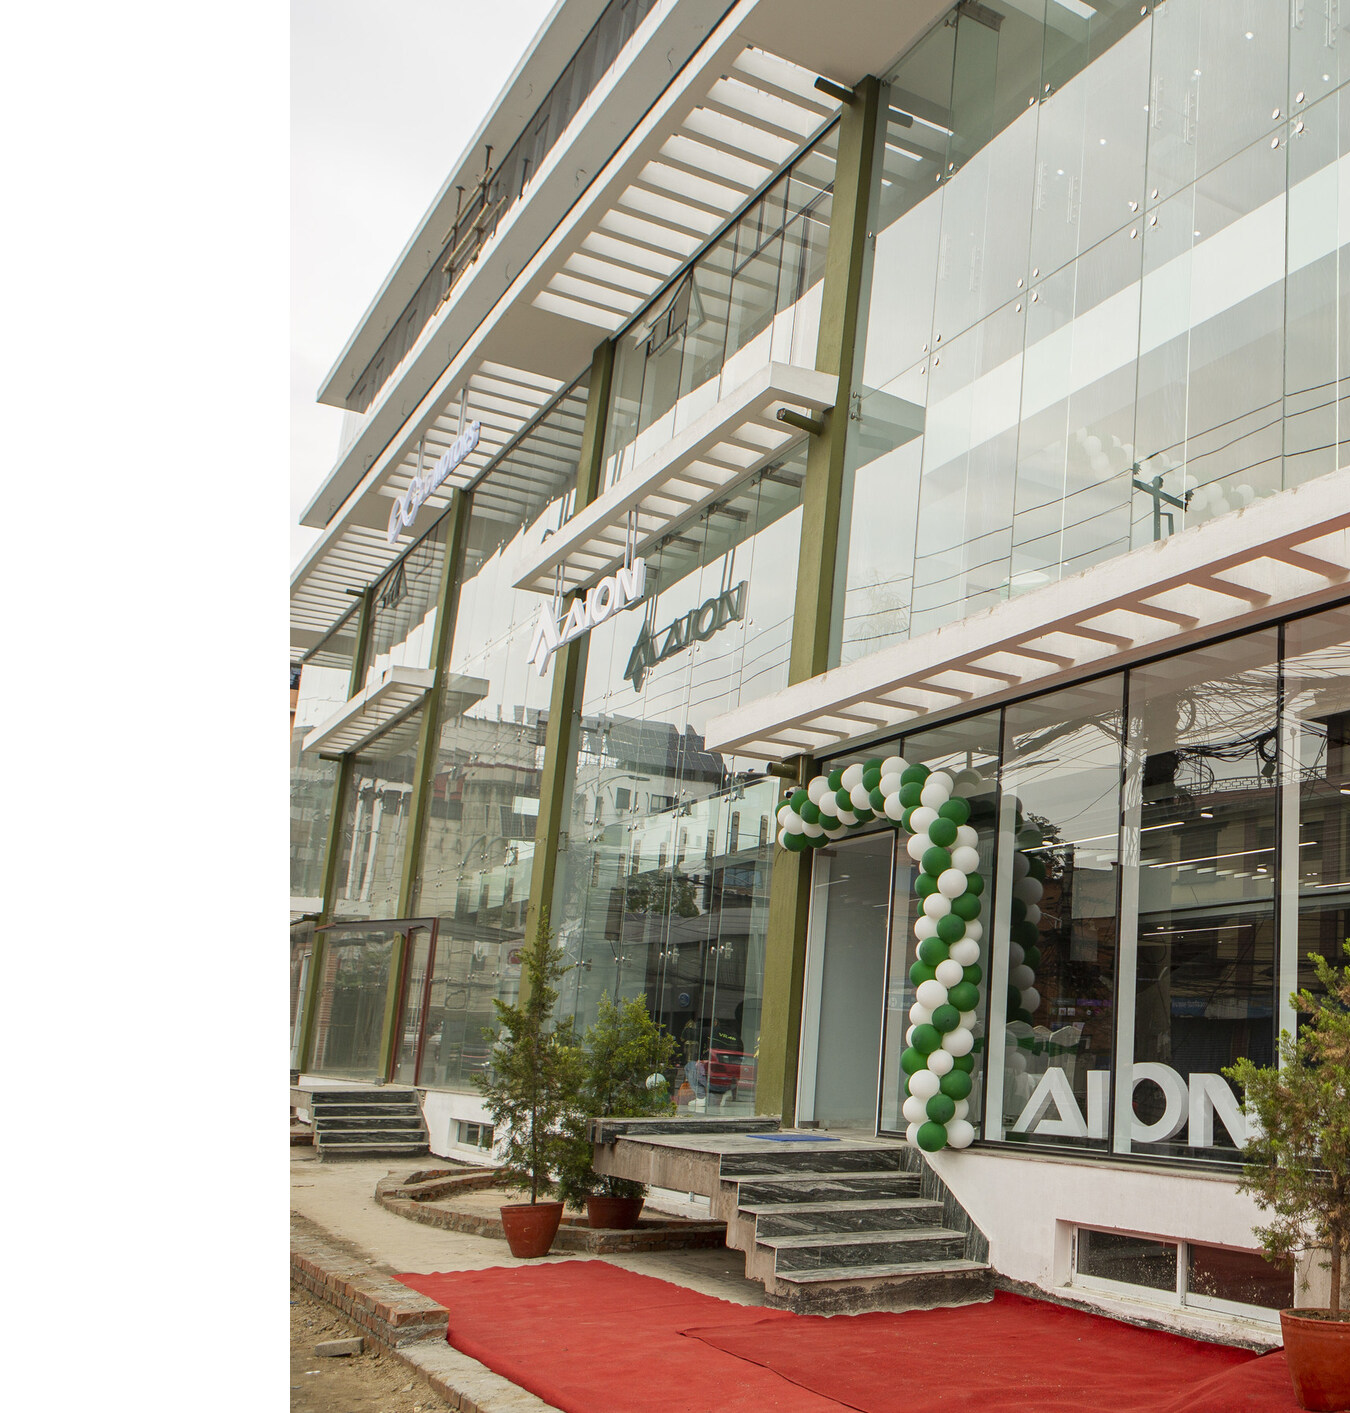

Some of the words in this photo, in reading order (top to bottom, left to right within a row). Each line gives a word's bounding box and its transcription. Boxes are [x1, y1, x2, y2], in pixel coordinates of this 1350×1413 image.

[559, 557, 646, 646] AION
[658, 580, 748, 661] AION
[1012, 1062, 1264, 1150] AION
